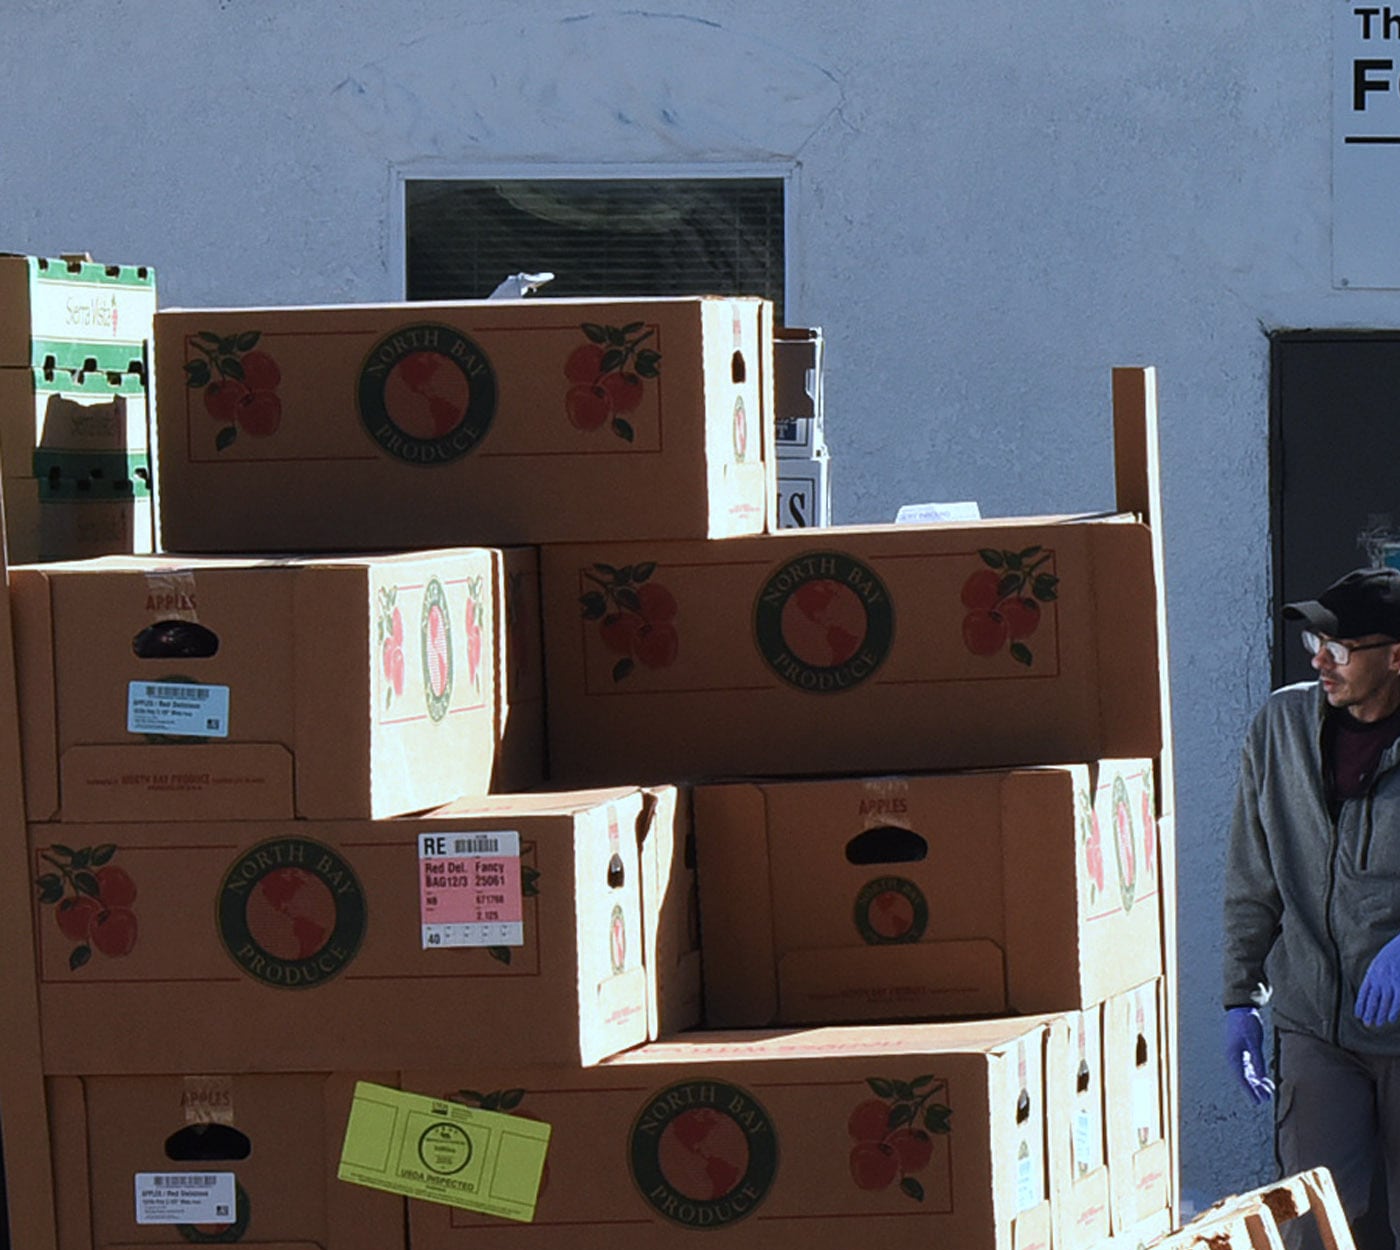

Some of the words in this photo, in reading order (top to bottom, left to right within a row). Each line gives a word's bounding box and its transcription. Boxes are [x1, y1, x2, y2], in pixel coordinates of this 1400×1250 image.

[368, 330, 439, 377] NORTH
[451, 340, 487, 376] BAY
[375, 424, 479, 462] PRODUCE
[765, 558, 836, 606] NORTH
[848, 566, 881, 605] BAY
[146, 594, 196, 611] APPLES
[774, 650, 876, 690] PRODUCE
[859, 799, 907, 815] APPLES
[424, 837, 446, 855] RE
[228, 844, 304, 895] NORTH
[317, 854, 354, 895] BAY
[425, 863, 444, 874] Red
[475, 862, 504, 873] Fancy
[240, 944, 346, 984] PRODUCE
[180, 1091, 231, 1107] APPLES
[639, 1085, 716, 1135] NORTH
[728, 1094, 768, 1134] BAY
[426, 1174, 475, 1192] INSPECTED
[650, 1183, 760, 1224] PRODUCE
